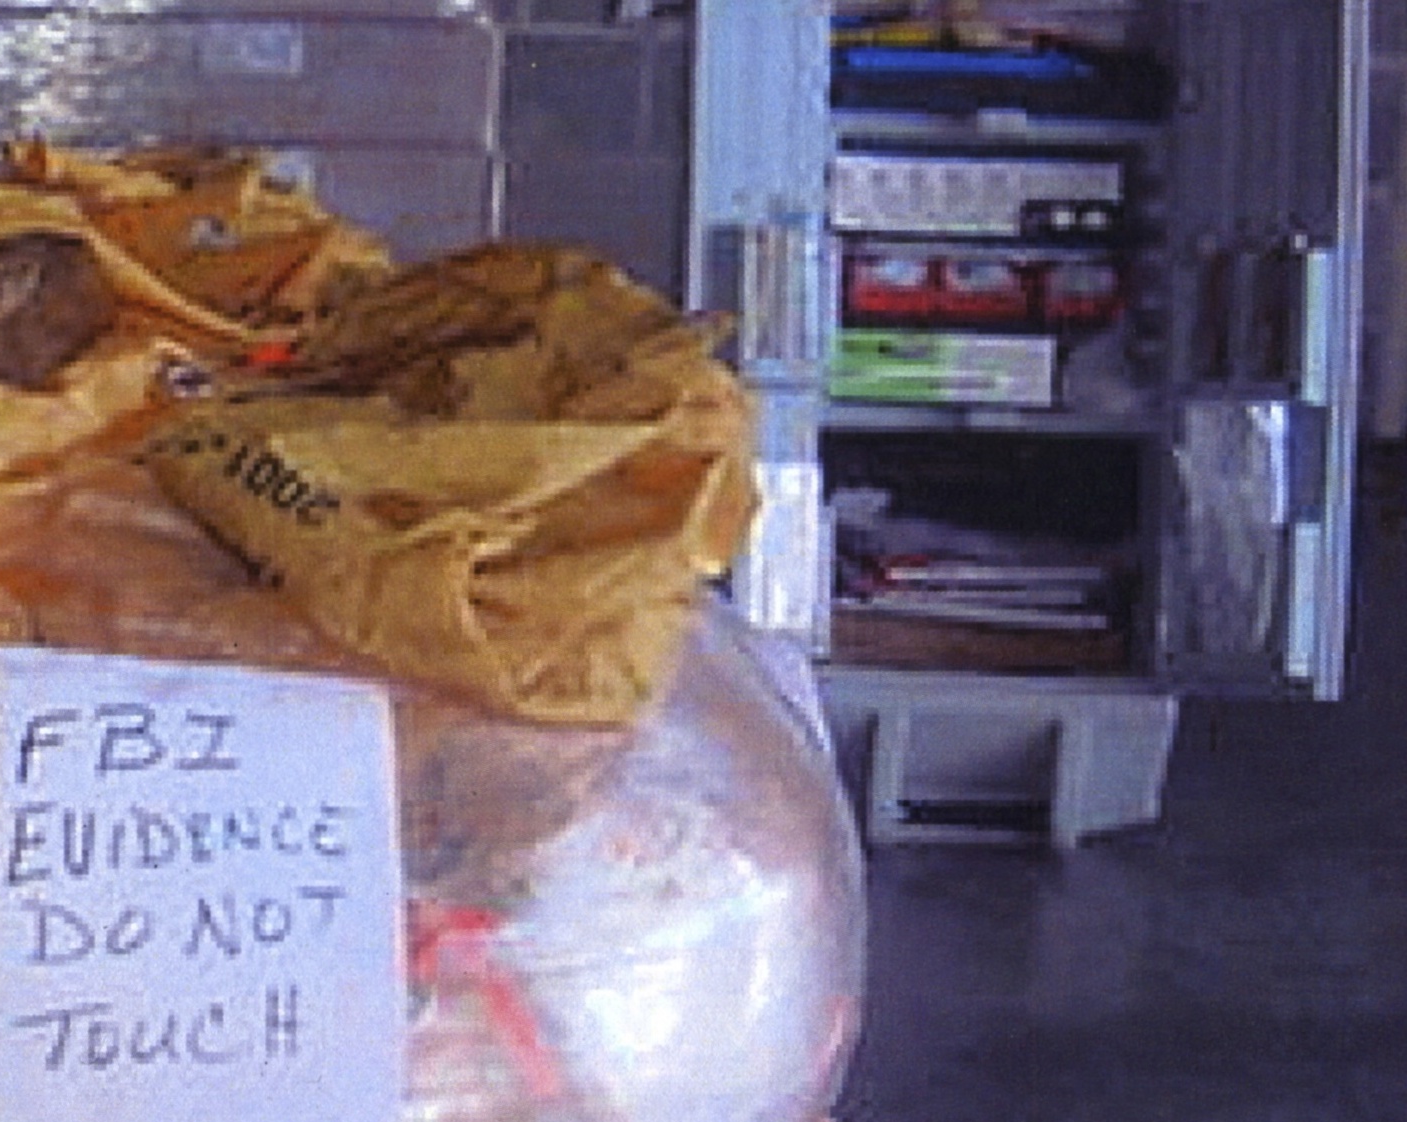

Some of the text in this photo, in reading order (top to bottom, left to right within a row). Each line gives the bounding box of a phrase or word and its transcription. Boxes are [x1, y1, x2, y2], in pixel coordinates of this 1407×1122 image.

[15, 702, 242, 784] FBI
[21, 885, 347, 966] DO NOT
[10, 982, 298, 1072] TOUCH
